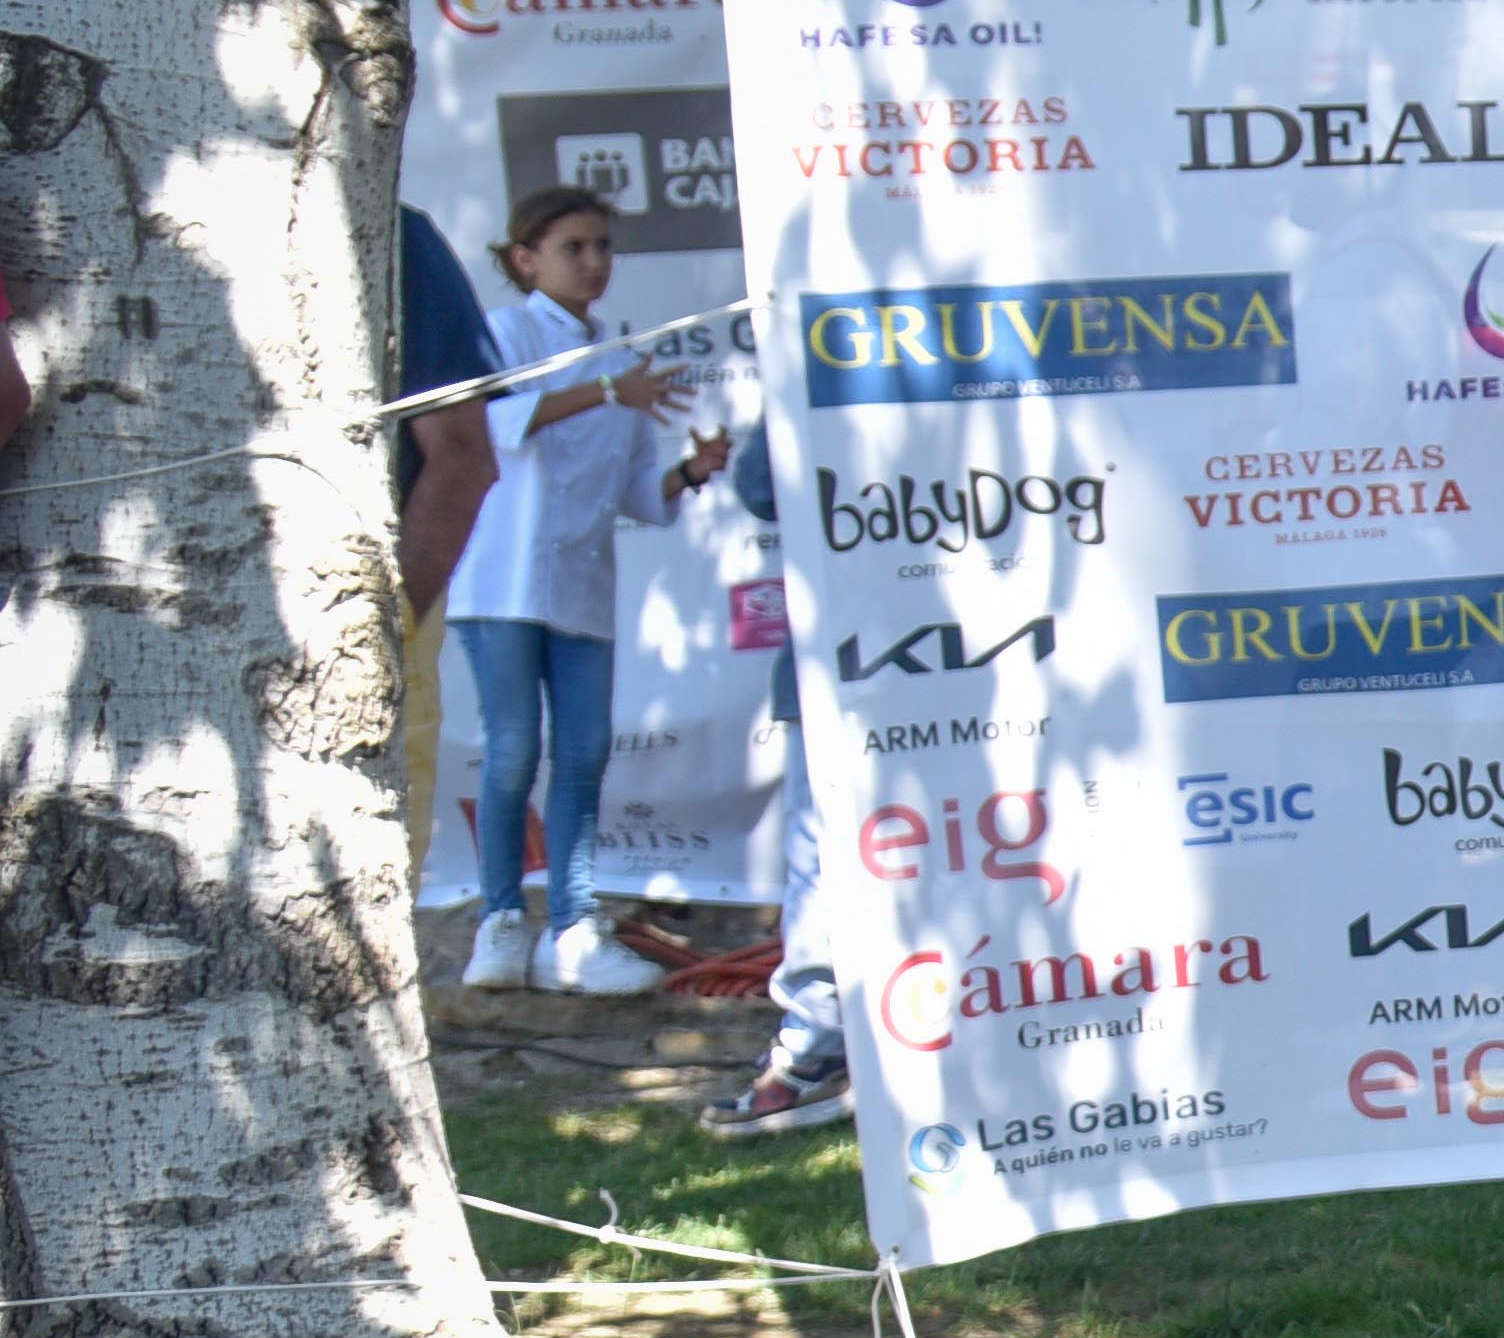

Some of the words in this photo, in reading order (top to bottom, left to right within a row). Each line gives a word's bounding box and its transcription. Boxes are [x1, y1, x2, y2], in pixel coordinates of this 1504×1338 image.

[553, 17, 674, 44] Granada
[800, 22, 957, 48] HAFESA
[968, 21, 1044, 46] OIL!
[812, 96, 1069, 130] CERVEZAS
[792, 135, 1097, 178] VICTORIA
[807, 290, 1290, 369] GRUVENSA
[951, 380, 1016, 399] GRUPO
[1203, 443, 1447, 482] CERVEZAS
[1183, 479, 1471, 528] VICTORIA
[836, 614, 1056, 682] KIA
[1298, 675, 1357, 693] GRUPO
[864, 721, 941, 756] ARM
[858, 787, 1067, 906] eig
[880, 934, 1271, 1053] Cámara
[1369, 997, 1443, 1026] ARM
[1016, 1006, 1164, 1051] Granada
[977, 1108, 1055, 1154] Las
[1068, 1087, 1227, 1136] Gabias
[1011, 1144, 1075, 1175] quién
[1079, 1139, 1109, 1160] no
[1114, 1133, 1133, 1154] le
[1138, 1135, 1165, 1152] va
[1186, 1118, 1269, 1148] gustar?
